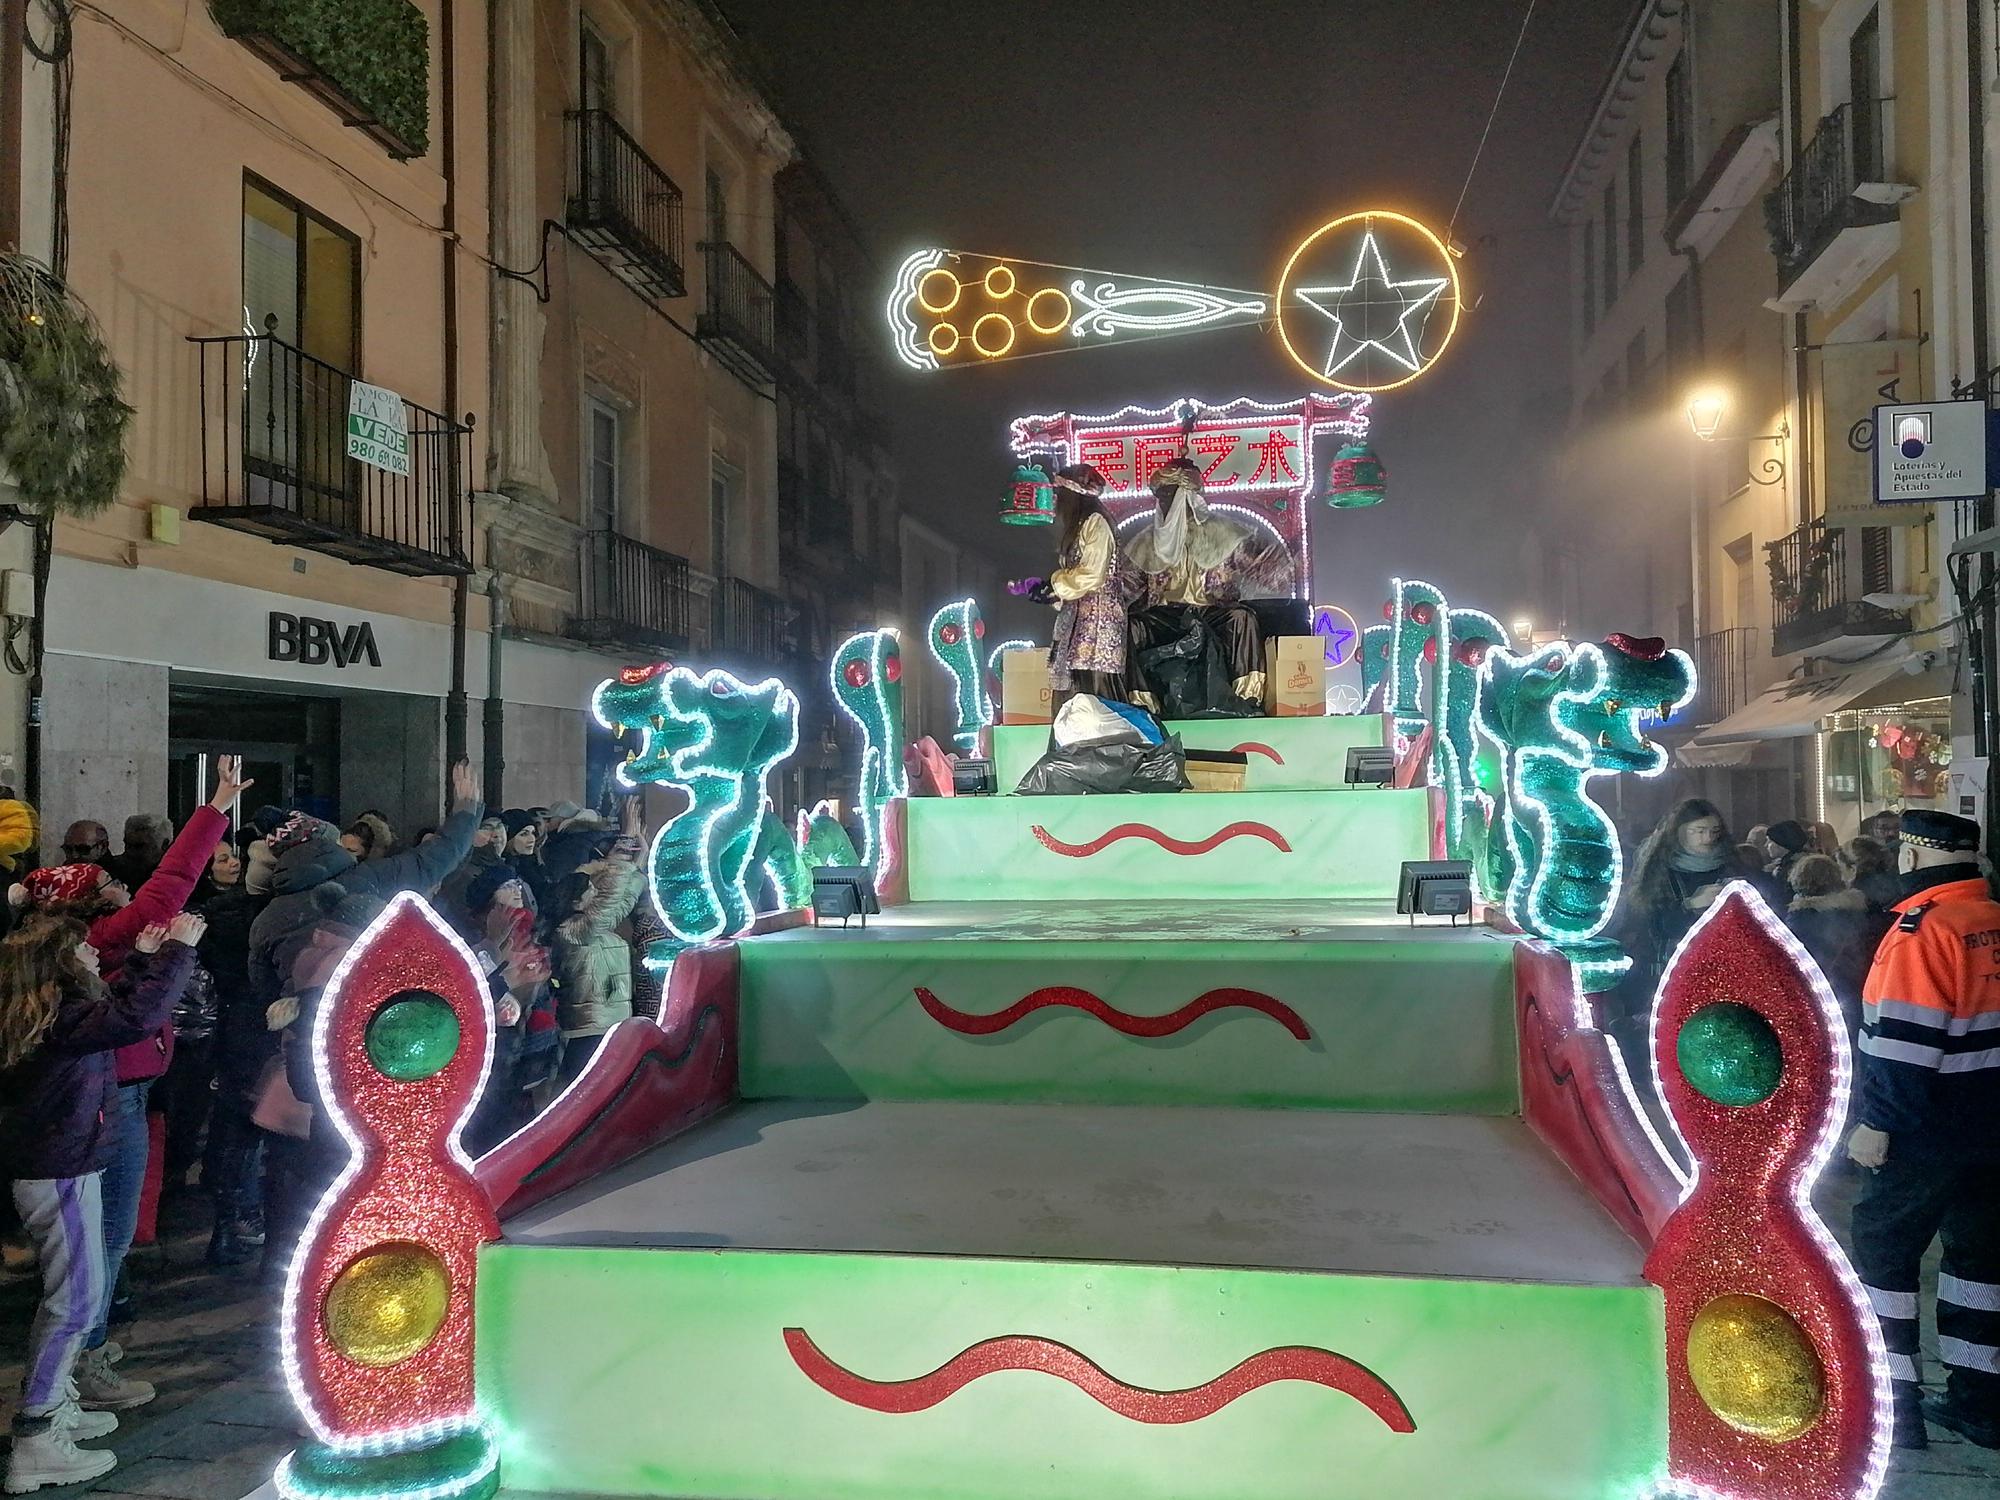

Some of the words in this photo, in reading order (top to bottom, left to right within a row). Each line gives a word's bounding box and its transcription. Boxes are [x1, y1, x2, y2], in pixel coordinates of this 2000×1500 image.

[350, 439, 376, 459] 980
[392, 454, 408, 473] 082
[1938, 460, 1946, 471] y
[1894, 472, 1944, 483] Apuestas
[1946, 469, 1962, 479] del
[1893, 482, 1930, 492] Estado
[268, 611, 382, 669] BBVA
